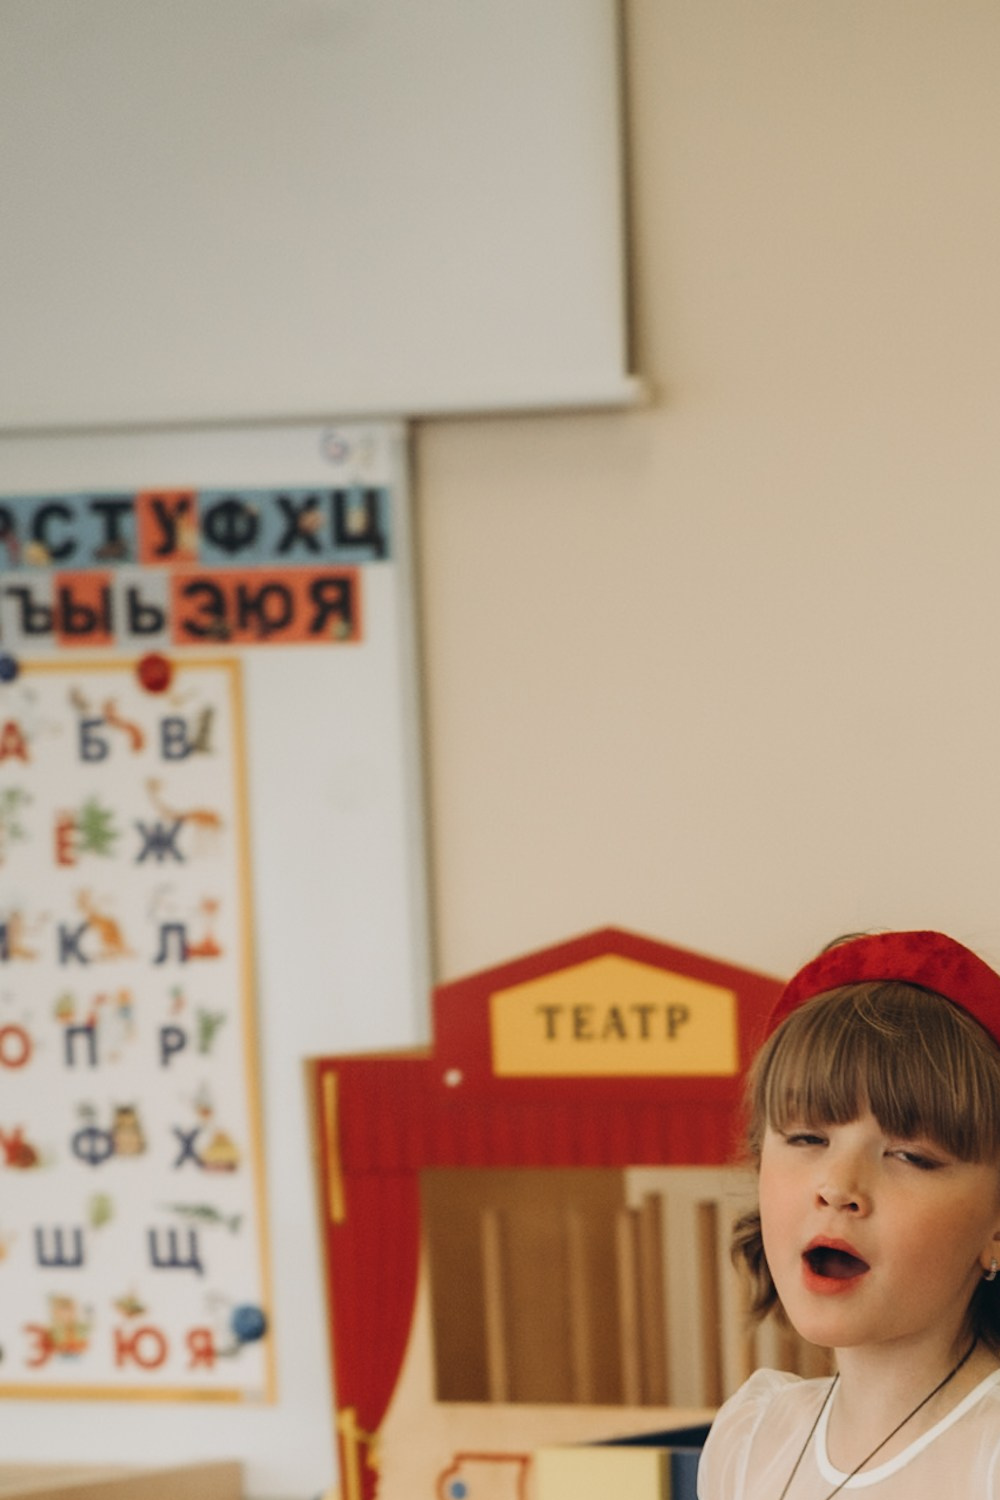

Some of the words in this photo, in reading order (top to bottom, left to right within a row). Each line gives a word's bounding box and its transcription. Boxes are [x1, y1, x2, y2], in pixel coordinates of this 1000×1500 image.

[0, 720, 30, 764] А
[79, 717, 109, 762] Б
[160, 716, 191, 761] В
[135, 820, 185, 864] Ж
[58, 922, 90, 966] К
[154, 922, 188, 966] Л
[535, 1003, 691, 1041] ТЕАТР
[0, 1025, 32, 1069] О
[65, 1026, 98, 1068] П
[159, 1026, 187, 1069] Р
[72, 1126, 114, 1167] Ф
[173, 1127, 203, 1169] Х
[35, 1226, 84, 1268] Ш
[148, 1226, 204, 1277] Щ
[24, 1323, 54, 1369] Э
[114, 1326, 168, 1370] Ю
[186, 1327, 216, 1370] Я
